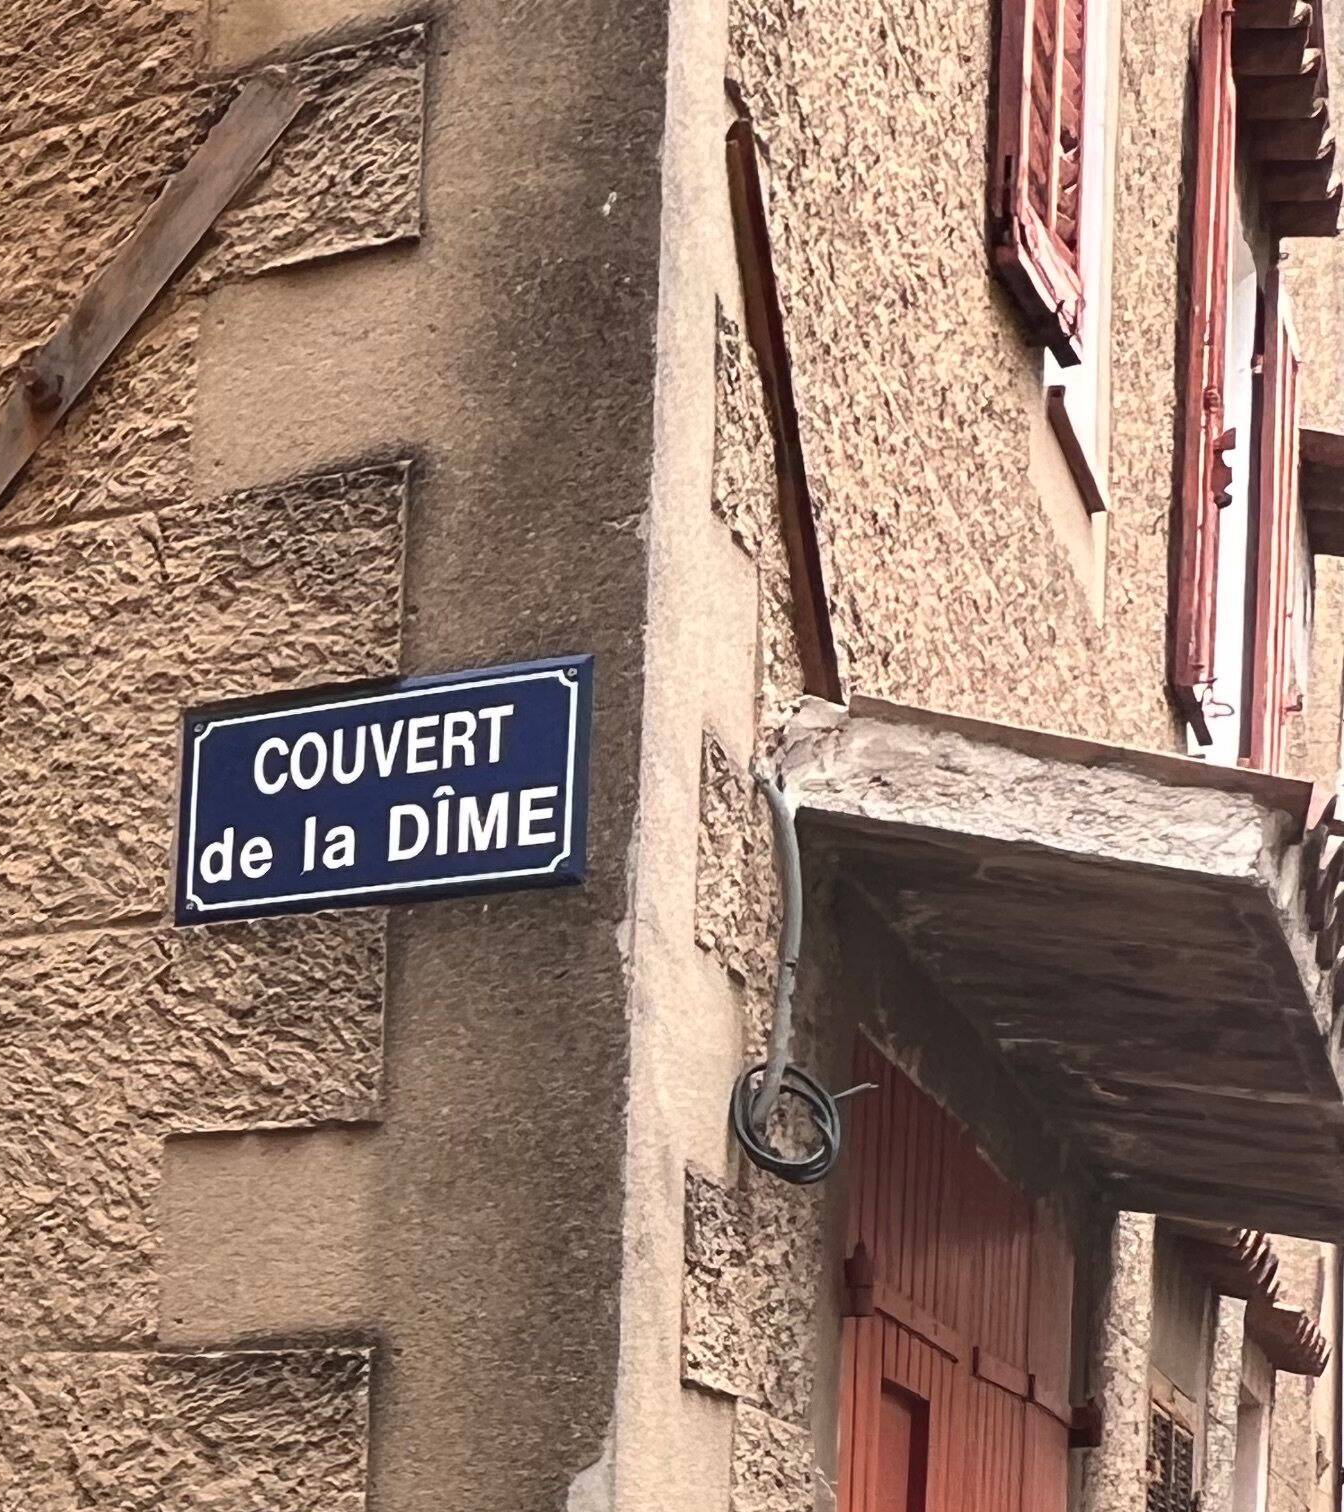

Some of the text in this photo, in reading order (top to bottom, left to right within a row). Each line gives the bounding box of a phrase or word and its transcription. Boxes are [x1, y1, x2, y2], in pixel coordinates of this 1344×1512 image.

[253, 704, 515, 795] COUVERT
[199, 785, 559, 885] de la DÎME
